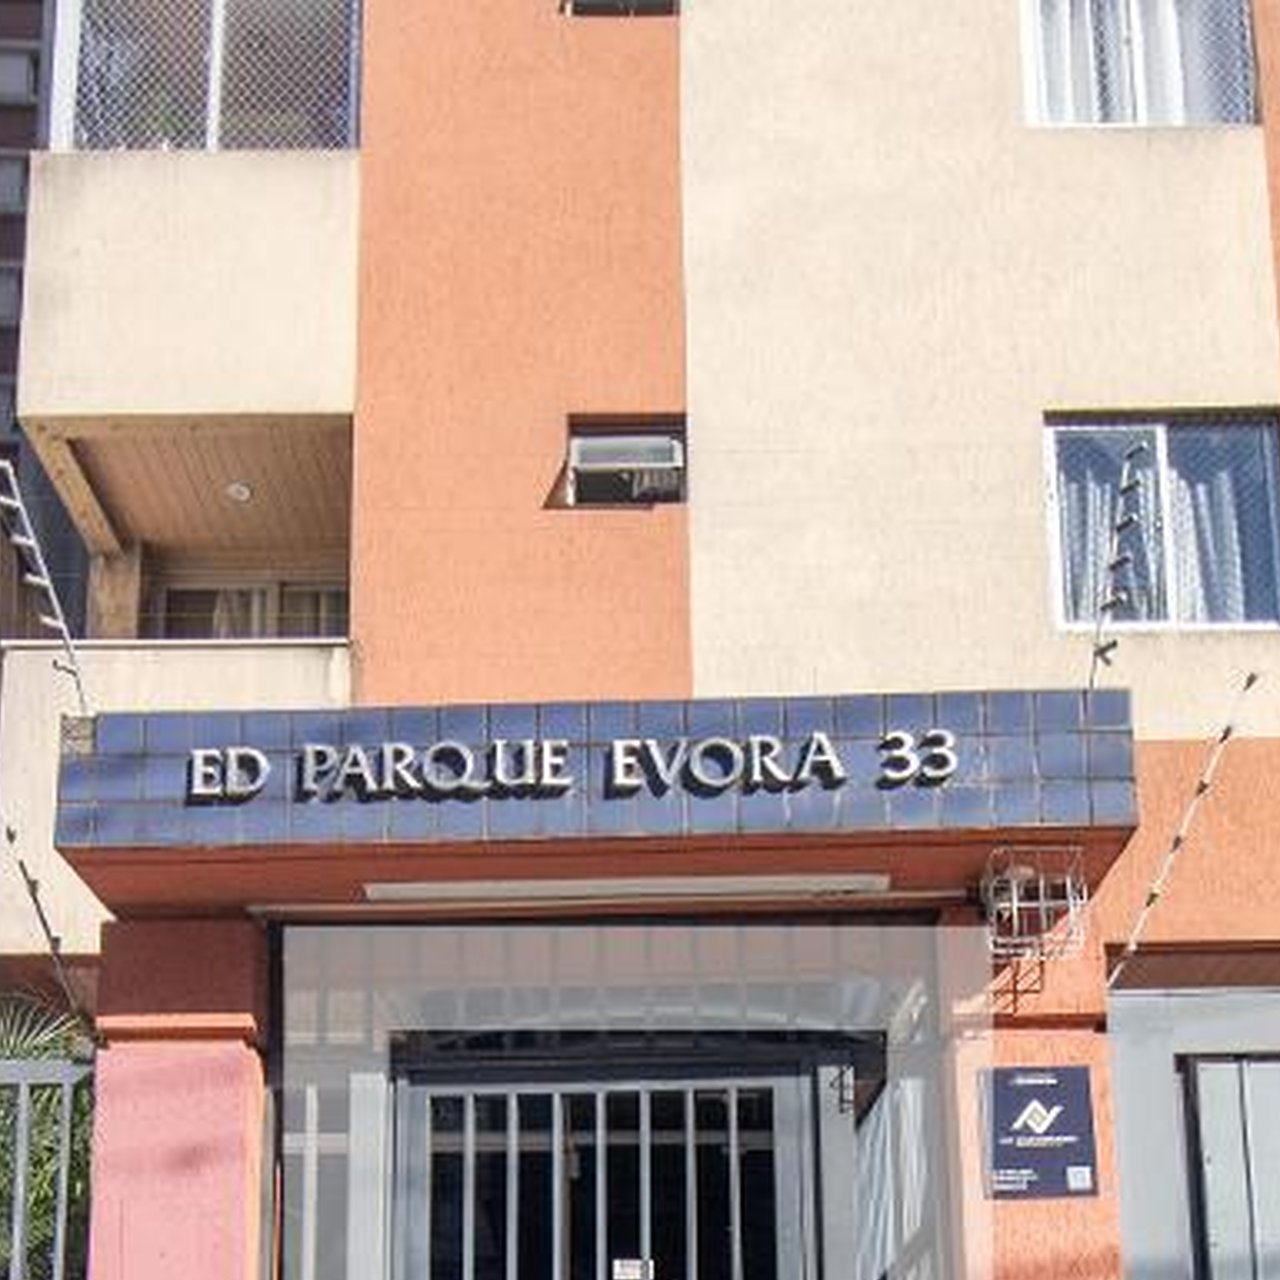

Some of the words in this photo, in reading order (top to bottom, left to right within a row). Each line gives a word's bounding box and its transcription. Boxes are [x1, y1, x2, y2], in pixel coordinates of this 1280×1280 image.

[189, 746, 271, 796] ED
[302, 738, 574, 793] PARQUE
[611, 731, 847, 786] EVORA
[879, 728, 959, 780] 33
